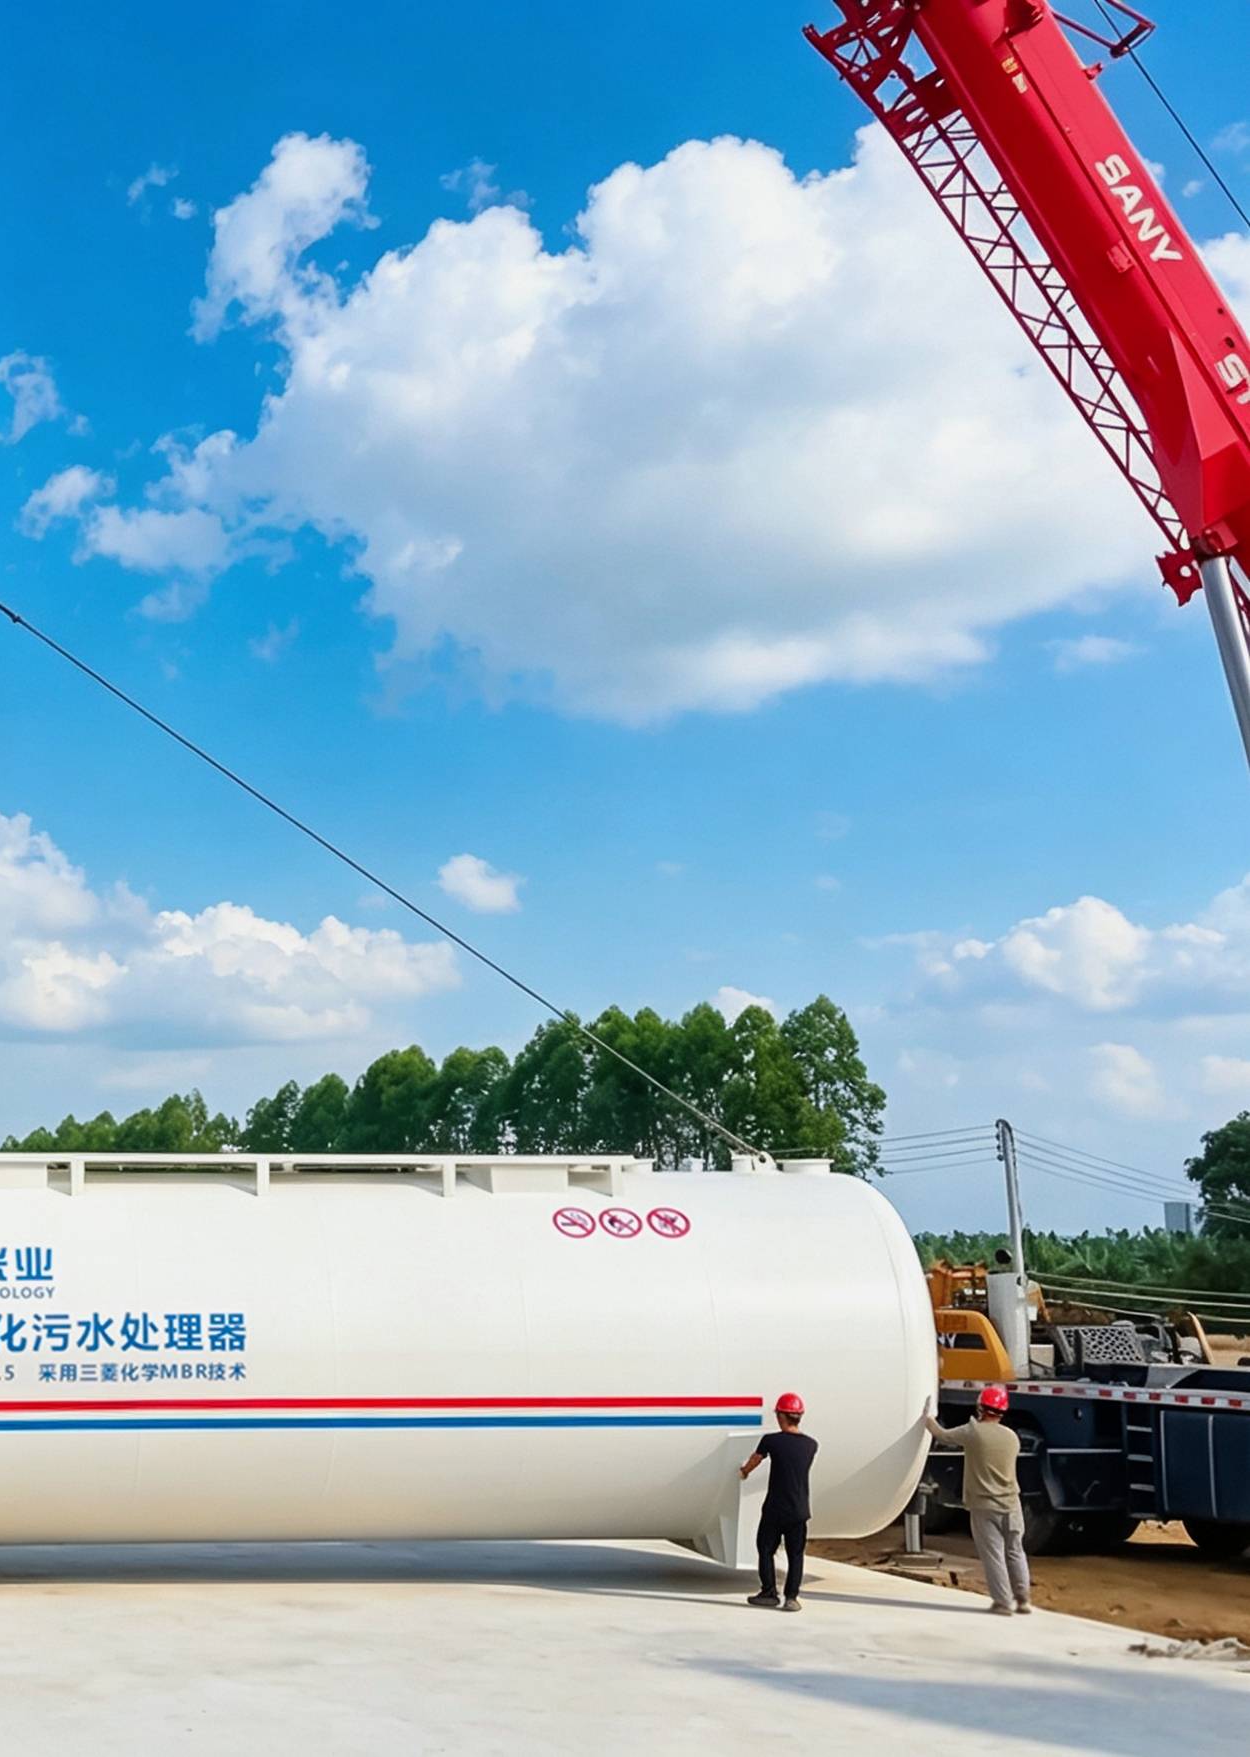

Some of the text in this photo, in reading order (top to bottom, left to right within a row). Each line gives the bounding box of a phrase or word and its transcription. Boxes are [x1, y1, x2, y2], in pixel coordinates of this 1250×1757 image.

[1094, 153, 1183, 262] SANY
[1214, 353, 1250, 405] S
[38, 1362, 247, 1382] 采用三菱化学MBR技术
